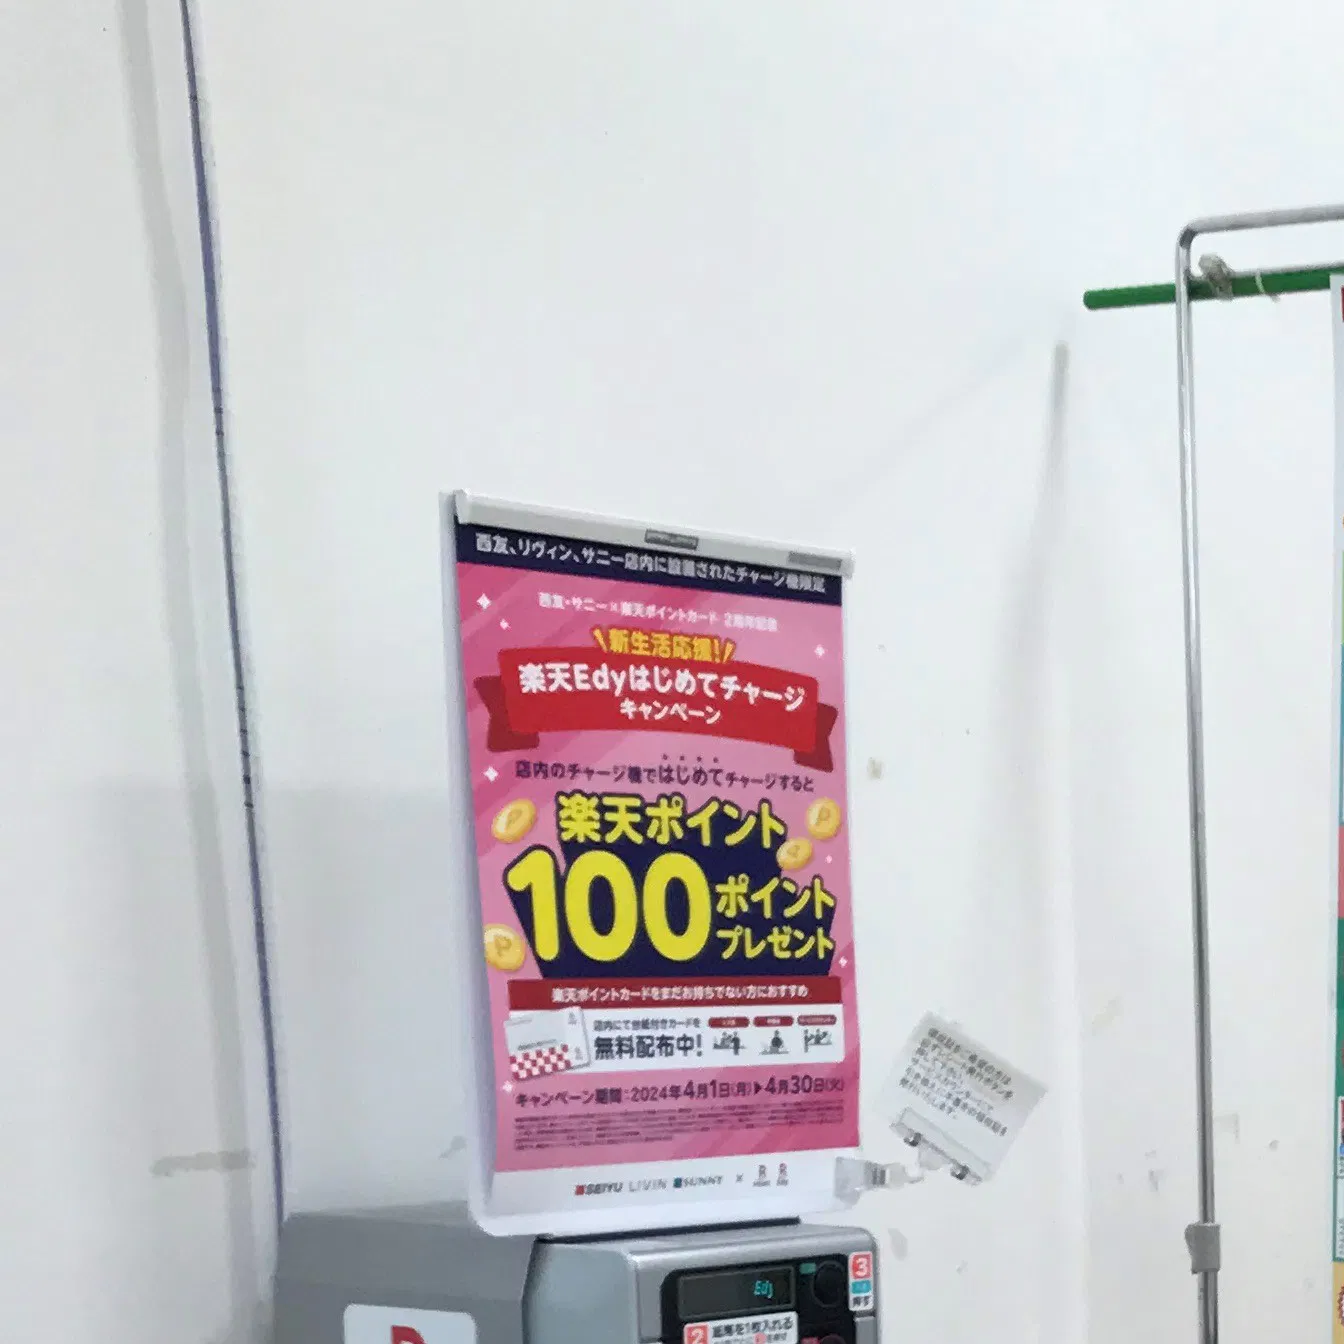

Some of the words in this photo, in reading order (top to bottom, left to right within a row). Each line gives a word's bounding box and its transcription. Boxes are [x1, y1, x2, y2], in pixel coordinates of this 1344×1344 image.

[518, 661, 806, 712] 楽天Edyはじめてチャージ
[619, 699, 722, 725] キャンペーン
[514, 759, 815, 793] 店内のチャージ機ではじめてチャージすると
[557, 792, 787, 848] 楽天ポイント
[506, 850, 712, 963] 100
[714, 877, 836, 919] ポイント
[714, 926, 836, 961] プレゼント
[593, 1033, 704, 1061] 無料配布中!
[855, 1256, 870, 1278] 3
[753, 1279, 774, 1299] Edy
